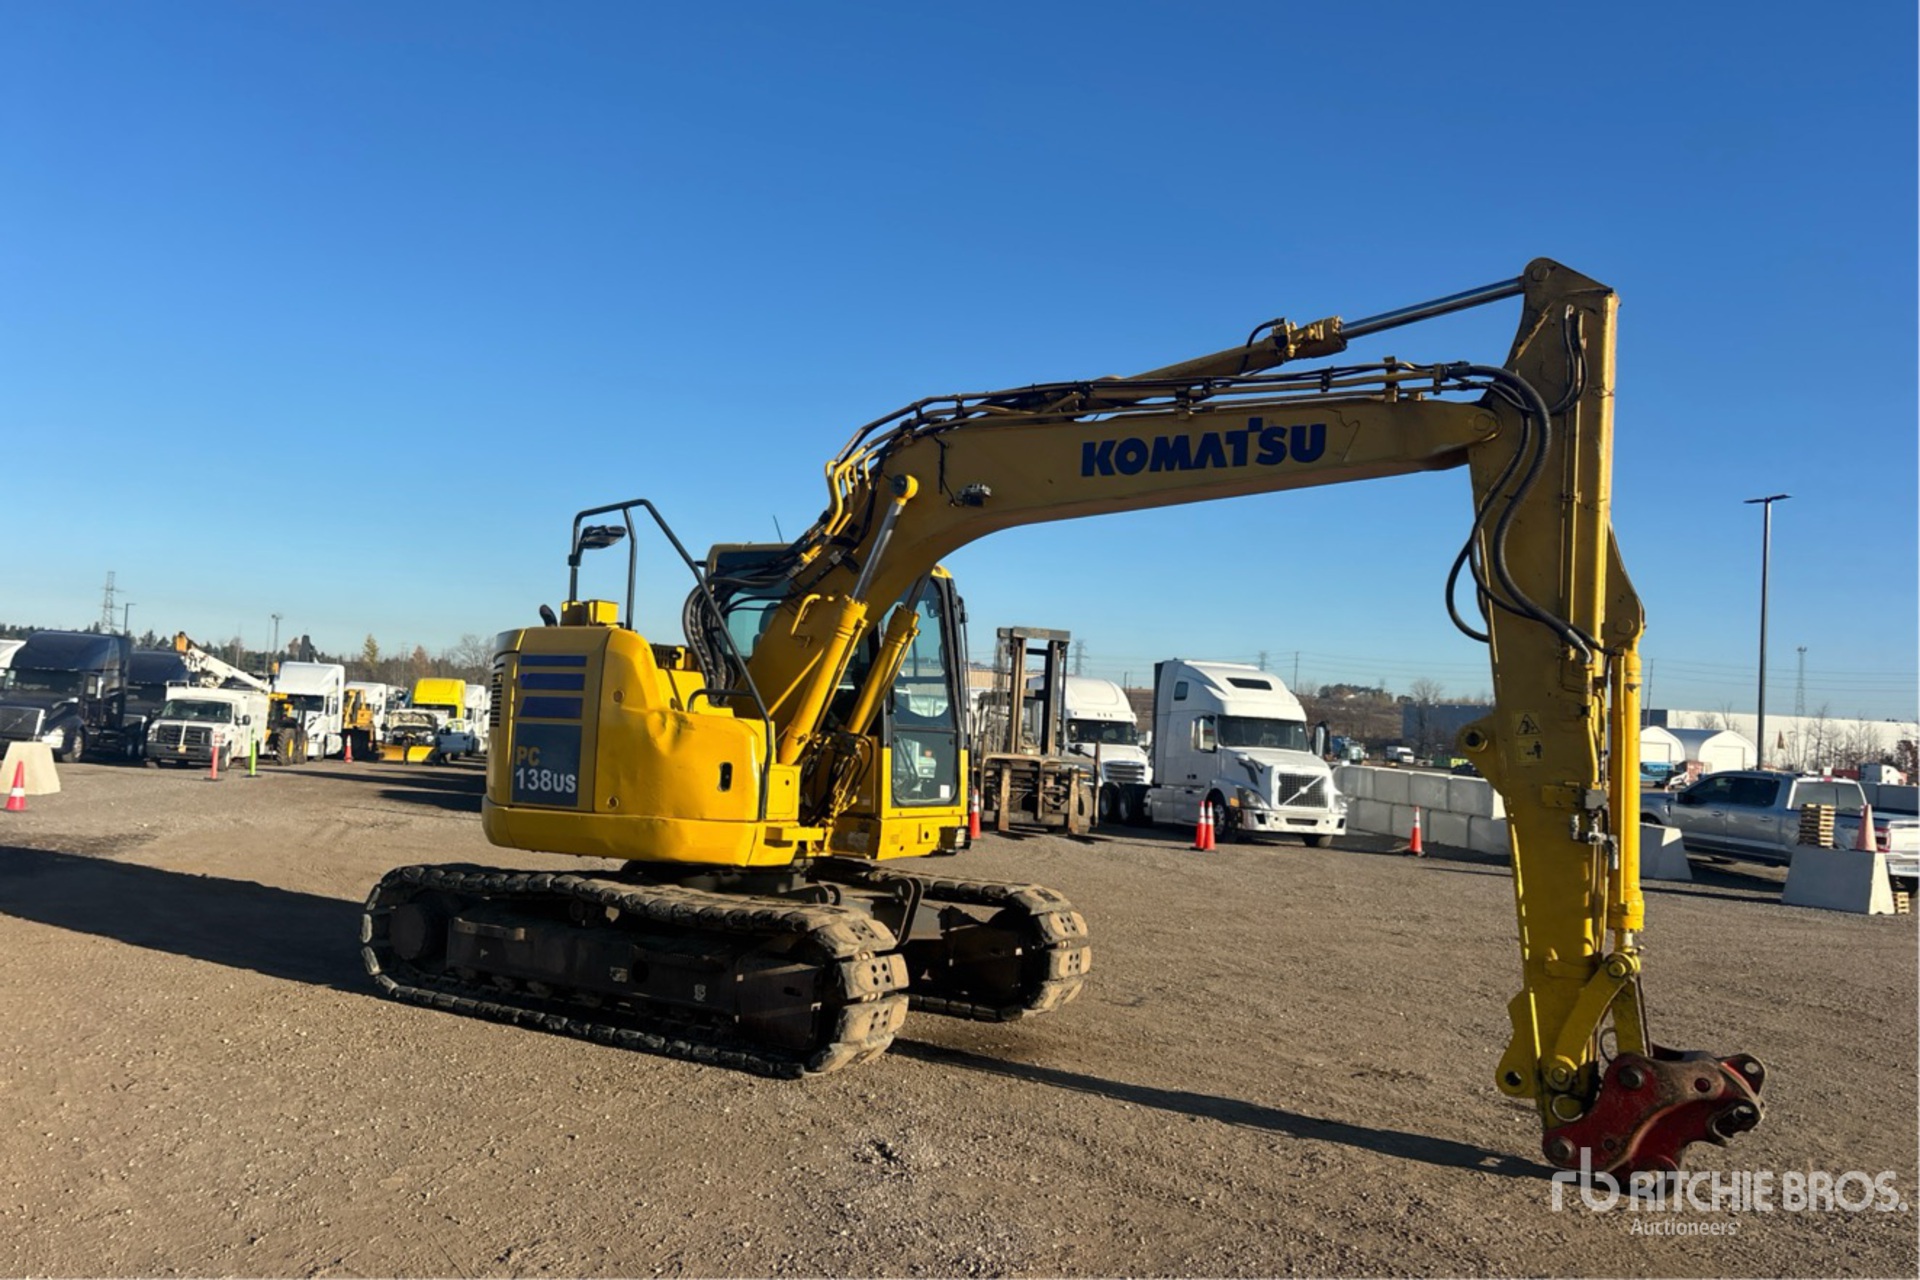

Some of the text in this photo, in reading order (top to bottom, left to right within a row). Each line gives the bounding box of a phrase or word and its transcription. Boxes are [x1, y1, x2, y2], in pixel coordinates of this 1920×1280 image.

[1081, 417, 1327, 477] KOMATSU
[516, 746, 540, 766] PC
[515, 767, 577, 793] 138US
